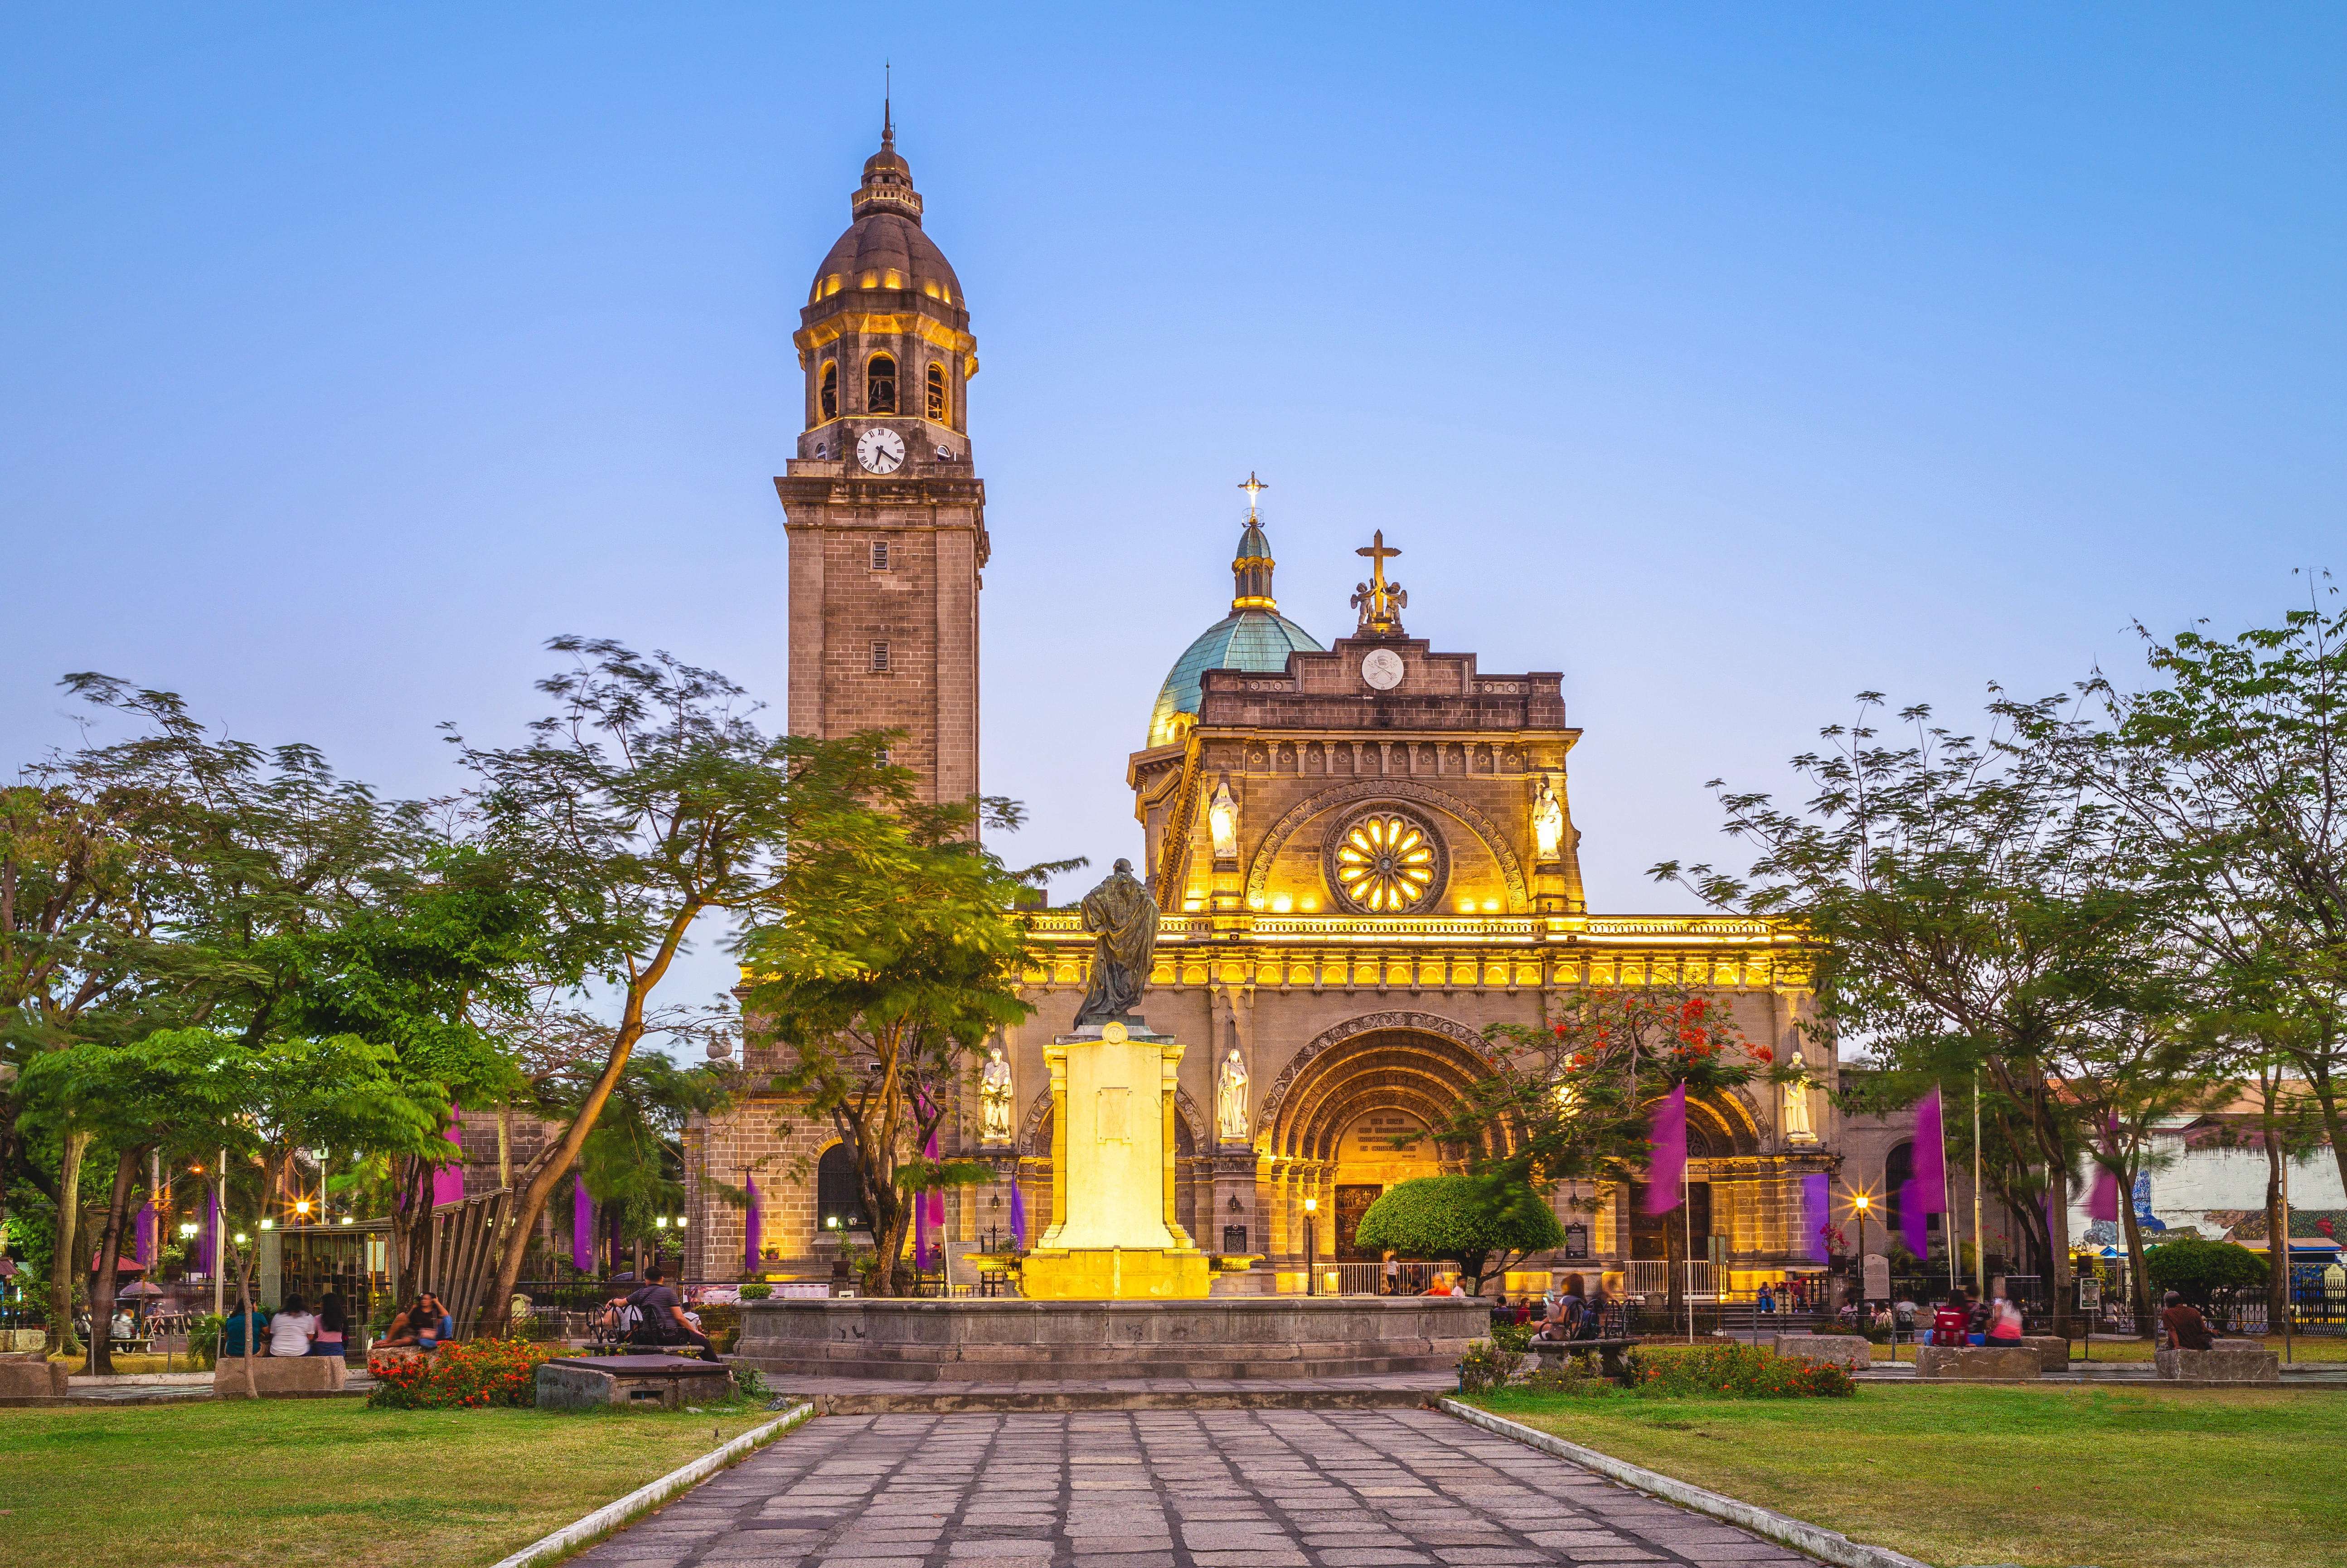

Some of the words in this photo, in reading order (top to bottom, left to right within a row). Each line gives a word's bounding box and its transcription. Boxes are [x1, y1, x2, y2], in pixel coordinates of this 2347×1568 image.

[868, 430, 875, 438] XI
[859, 455, 868, 465] VIII
[867, 462, 875, 471] VII
